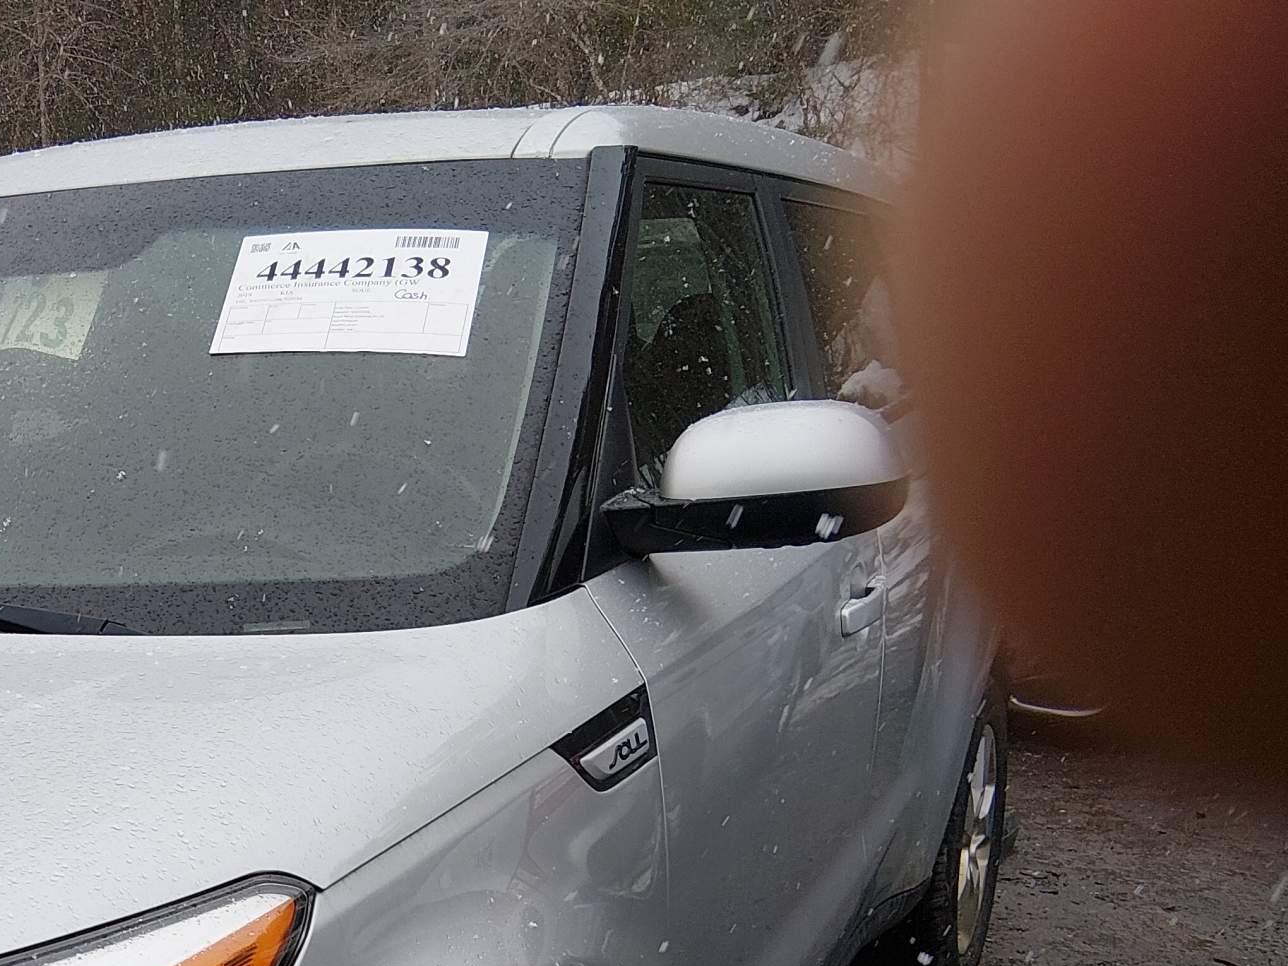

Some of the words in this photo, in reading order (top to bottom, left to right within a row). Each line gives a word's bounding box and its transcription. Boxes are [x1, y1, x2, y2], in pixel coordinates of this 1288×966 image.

[256, 256, 451, 282] 44442138
[238, 283, 291, 292] Commerce
[294, 280, 341, 288] Insurance
[344, 279, 392, 288] Company
[394, 289, 428, 300] Cash
[609, 733, 648, 769] SOUL
